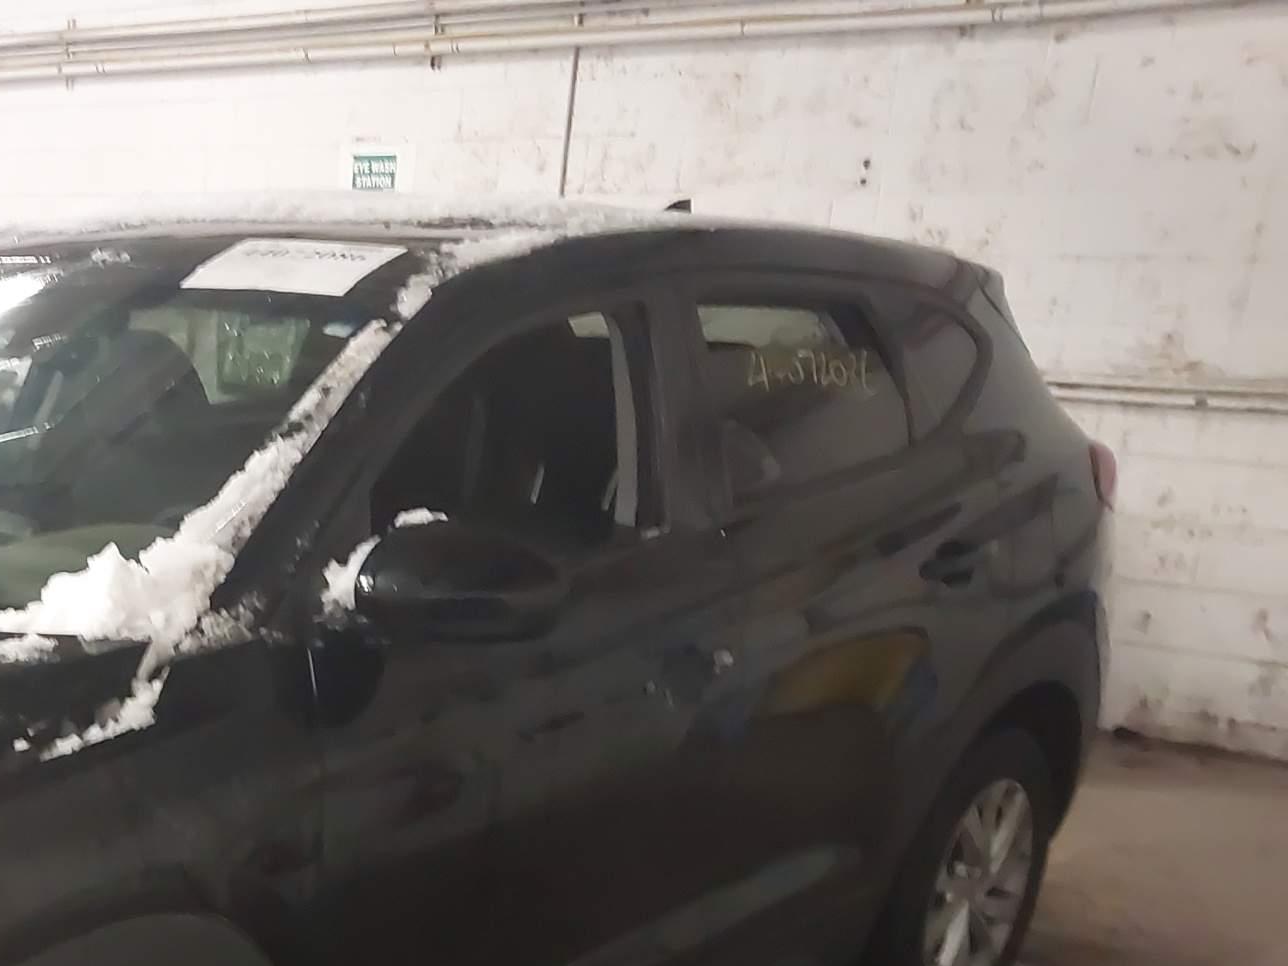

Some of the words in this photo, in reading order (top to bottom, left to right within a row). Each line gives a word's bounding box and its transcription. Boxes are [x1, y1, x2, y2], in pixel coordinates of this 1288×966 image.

[354, 160, 370, 174] EYE
[371, 159, 397, 174] WASH
[355, 174, 392, 188] STATION
